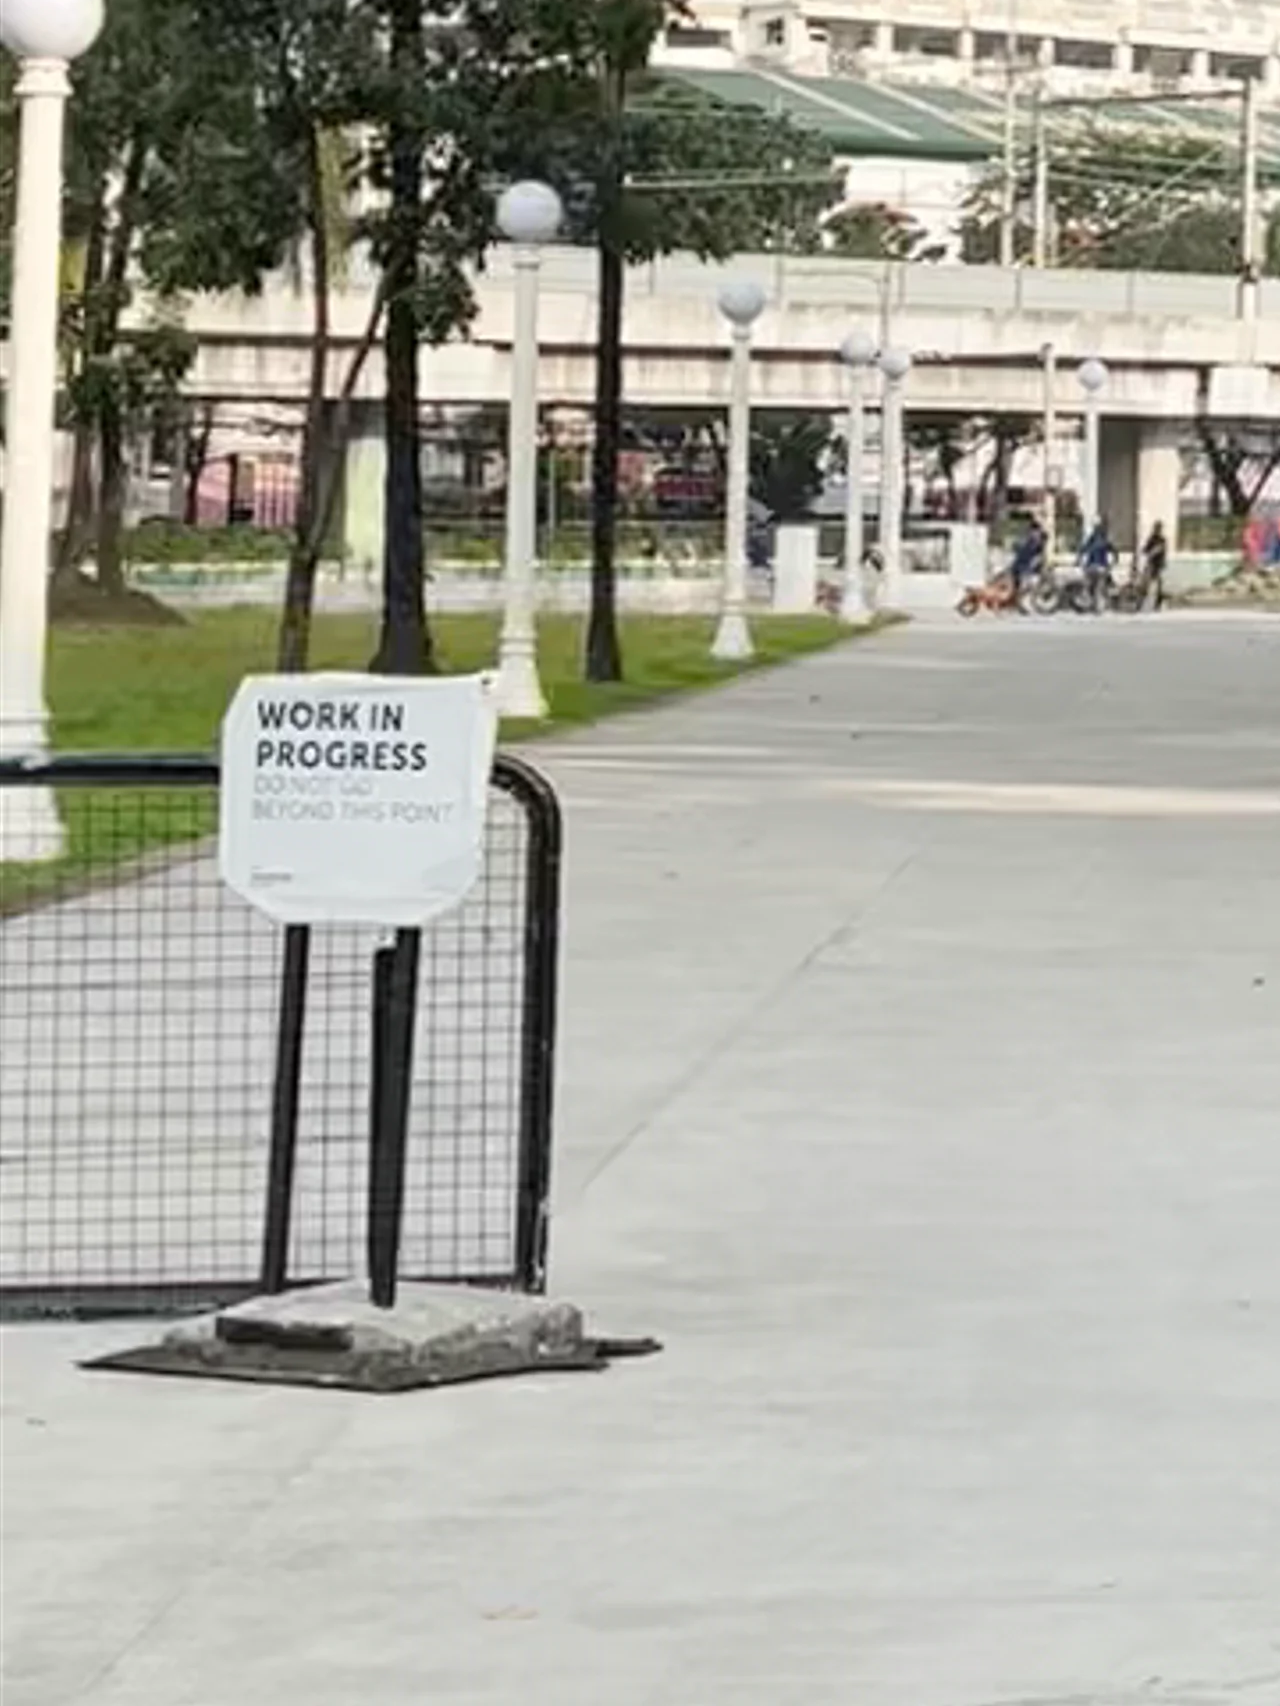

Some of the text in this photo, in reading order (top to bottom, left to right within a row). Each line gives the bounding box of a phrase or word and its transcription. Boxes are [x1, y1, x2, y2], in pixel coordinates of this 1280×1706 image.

[257, 700, 405, 732] WORK IN
[256, 739, 428, 771] PROGRESS
[254, 774, 285, 795] DO
[252, 800, 454, 824] BEYOND THIS POINT
